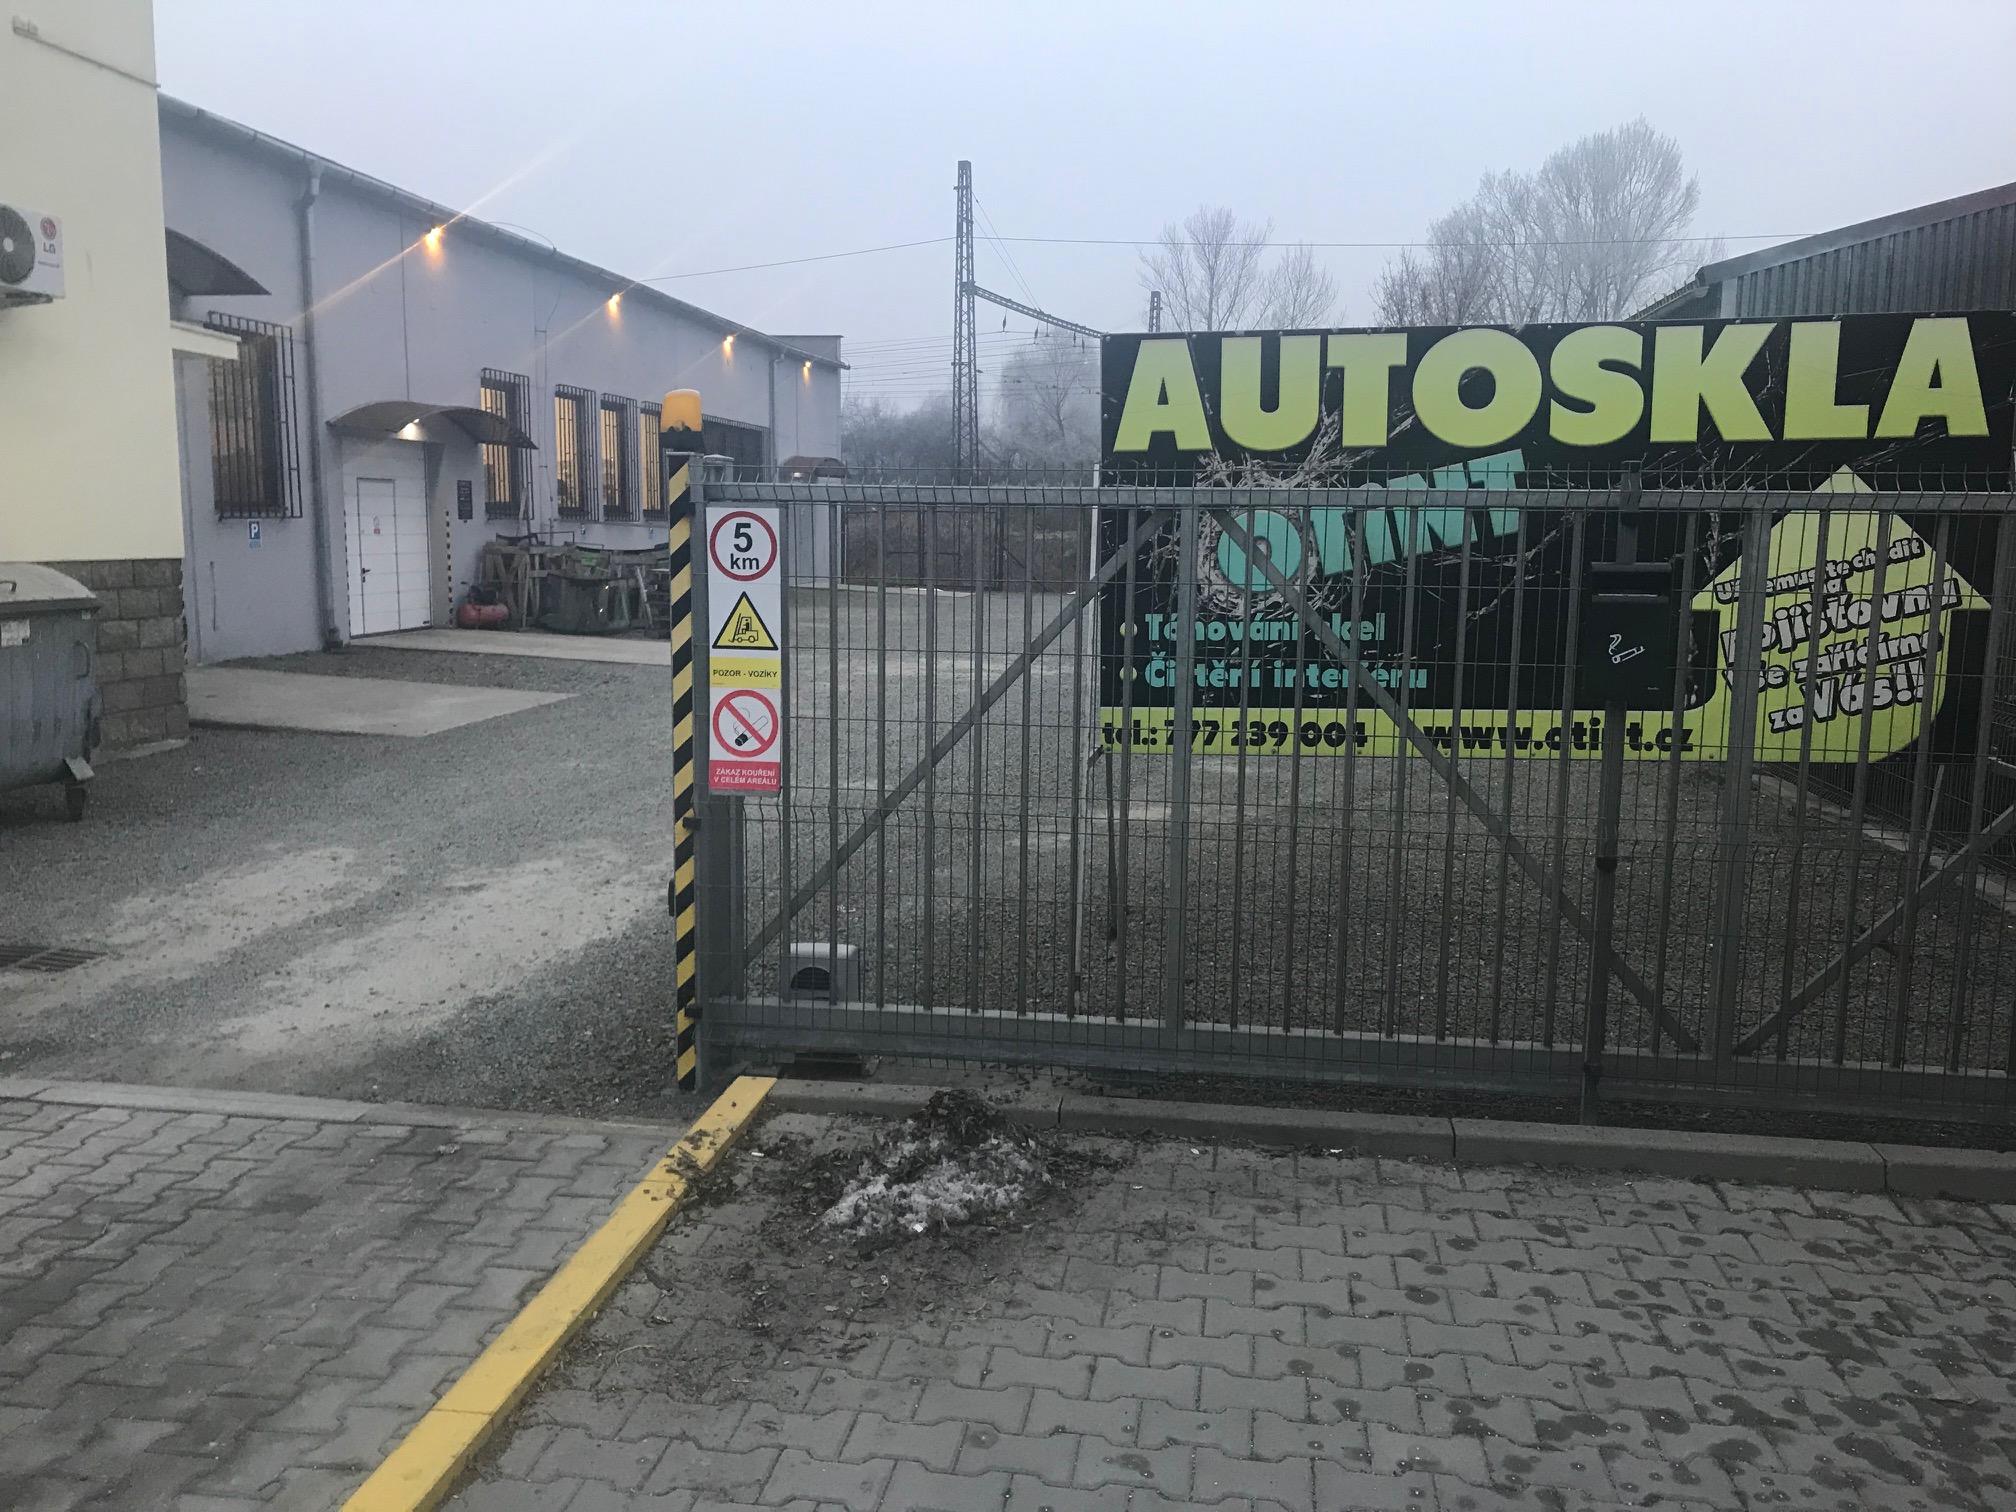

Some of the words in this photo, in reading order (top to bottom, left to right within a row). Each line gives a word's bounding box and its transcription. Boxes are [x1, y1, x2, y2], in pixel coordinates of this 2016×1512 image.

[42, 242, 56, 254] LG
[1113, 317, 1990, 451] AUTOSKLA
[250, 523, 259, 538] P
[733, 523, 753, 553] 5
[730, 553, 759, 570] km
[1748, 561, 1850, 596] emuste
[1851, 539, 1922, 570] chdit
[713, 669, 741, 677] POZOR
[748, 669, 778, 678] VOZÍKY
[1145, 651, 1262, 688] Čitění
[1274, 659, 1428, 688] interéru
[1230, 720, 1289, 747] 239
[1300, 721, 1368, 748] 004
[1422, 716, 1694, 752] www.ctit.cz
[715, 768, 741, 776] ZÁKAZ
[741, 768, 776, 777] KOUŘENÍ
[720, 776, 746, 784] CELÉM
[746, 776, 778, 786] AREÁLU
